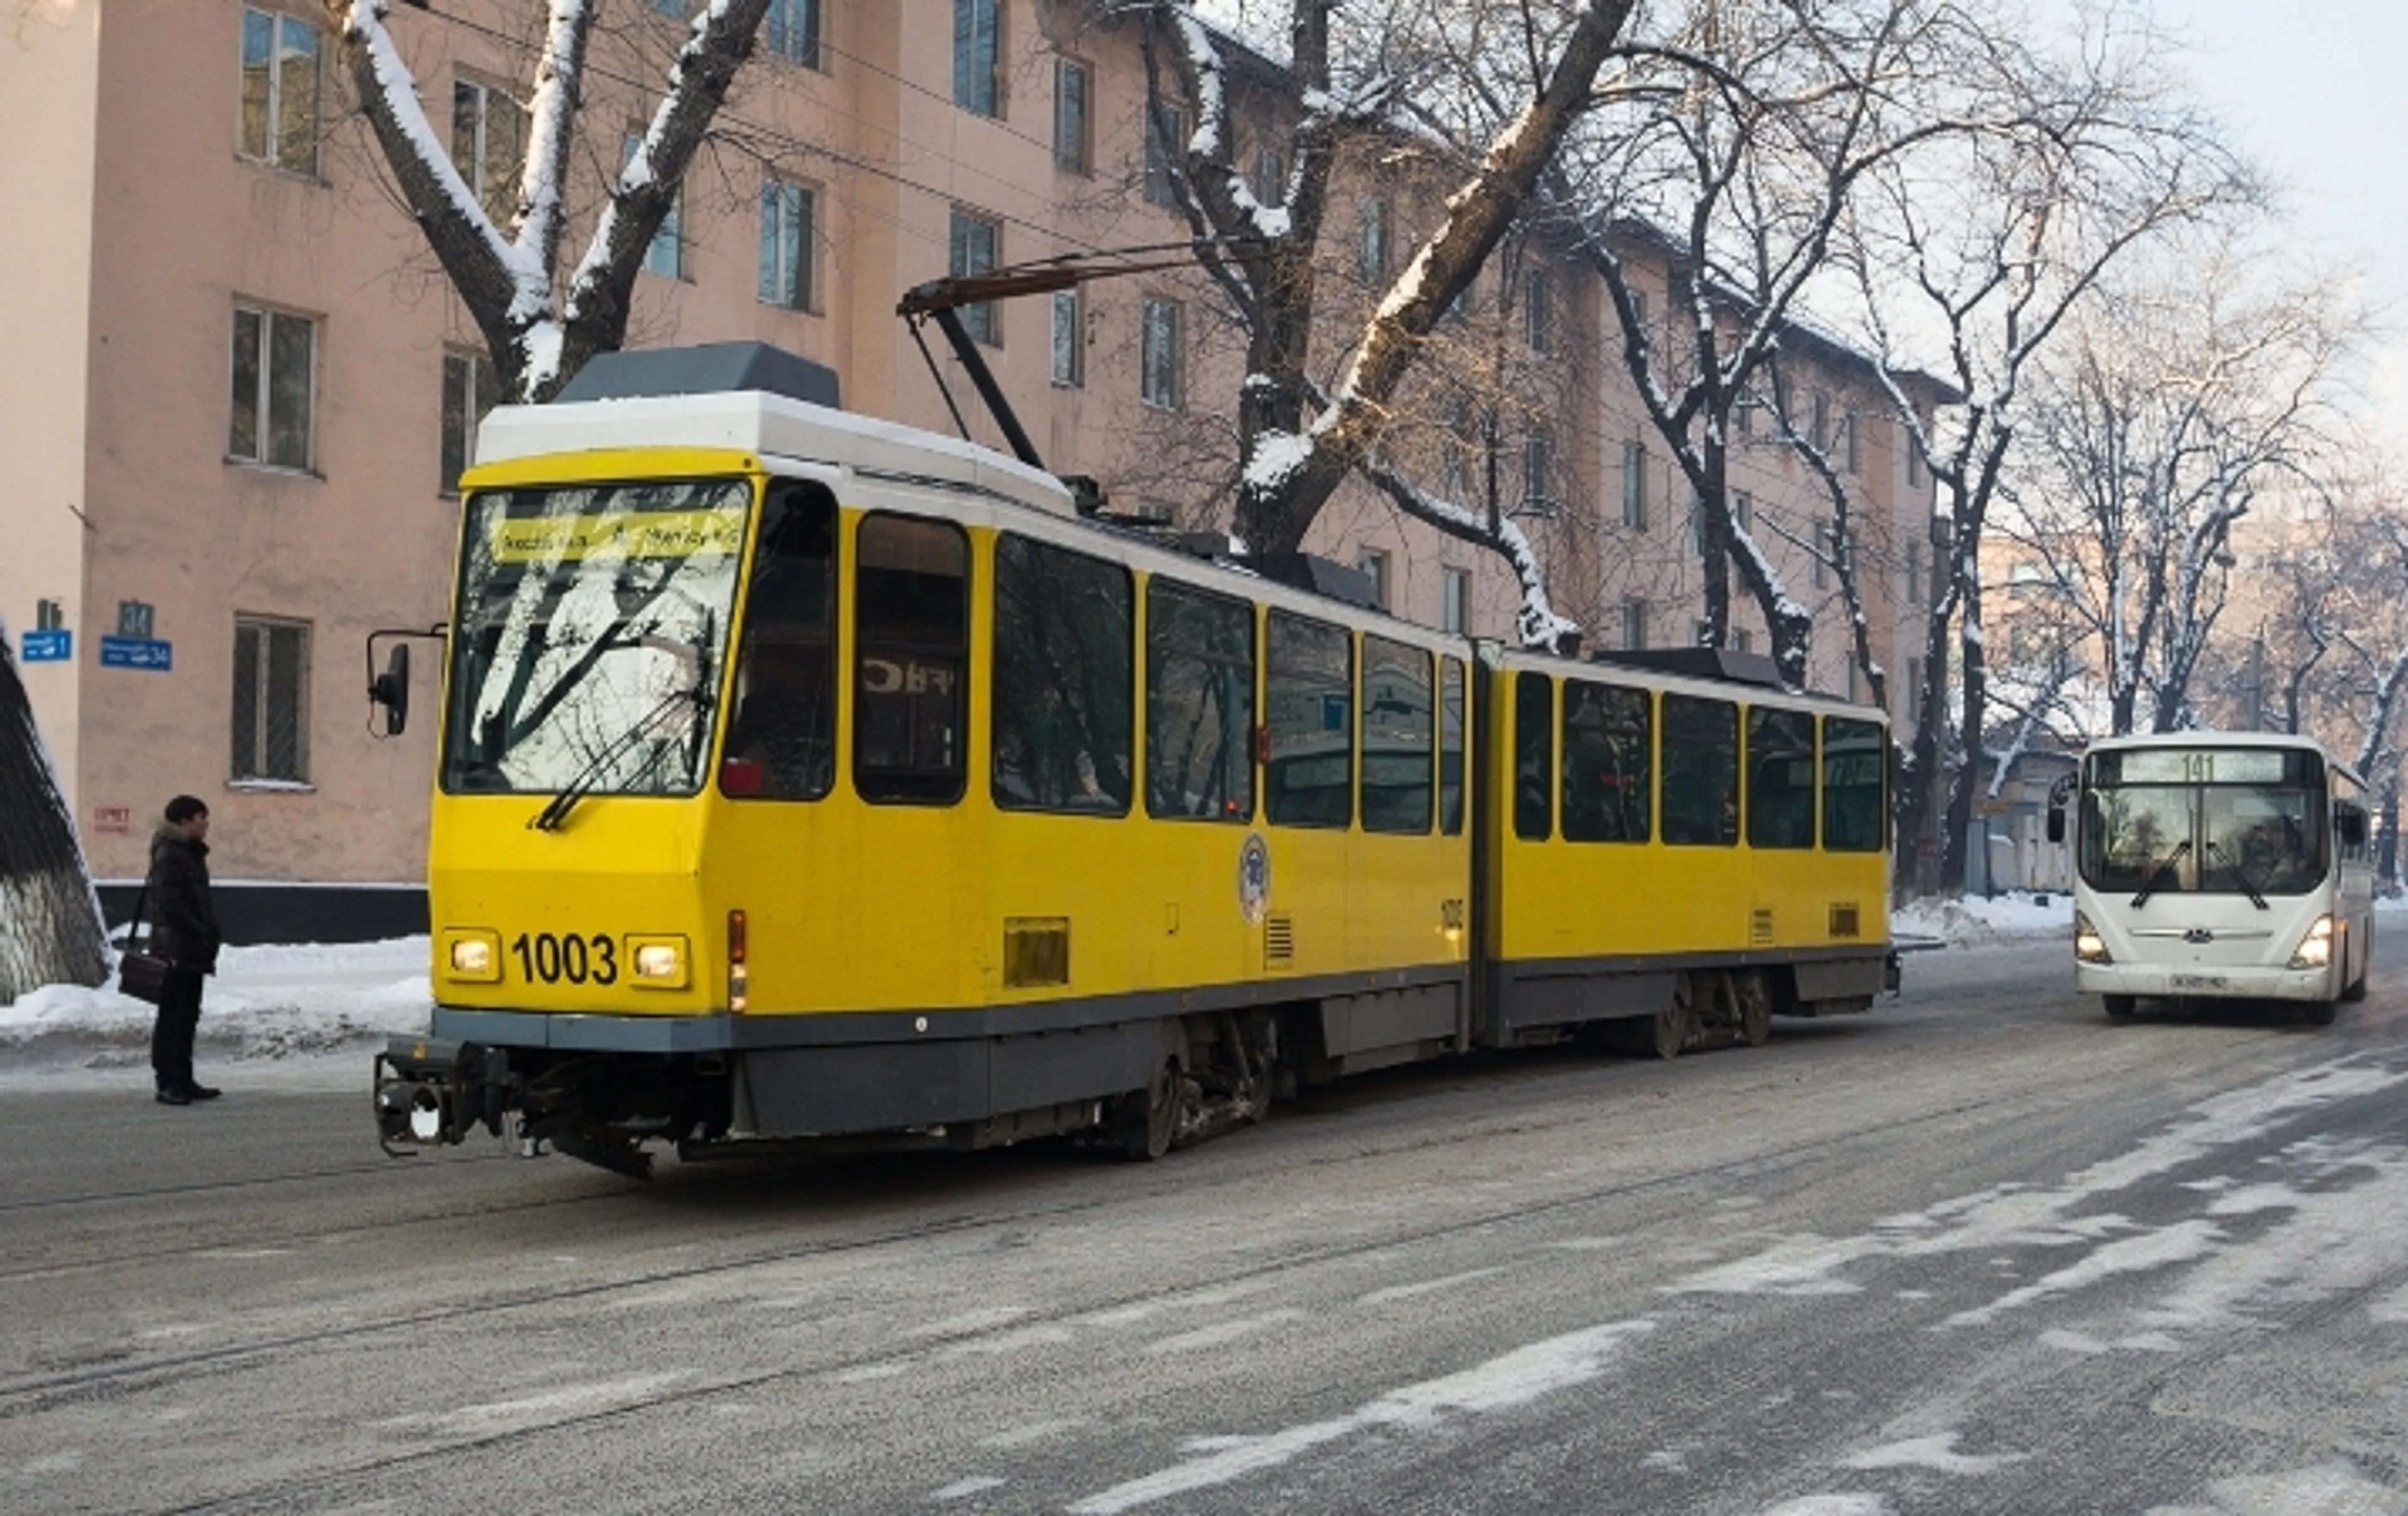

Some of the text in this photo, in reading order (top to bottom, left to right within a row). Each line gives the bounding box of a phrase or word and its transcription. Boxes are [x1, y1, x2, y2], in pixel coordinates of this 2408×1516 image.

[124, 606, 147, 635] 34
[59, 635, 66, 655] 1
[150, 646, 167, 664] 34
[2182, 753, 2214, 782] 141
[512, 932, 618, 985] 1003
